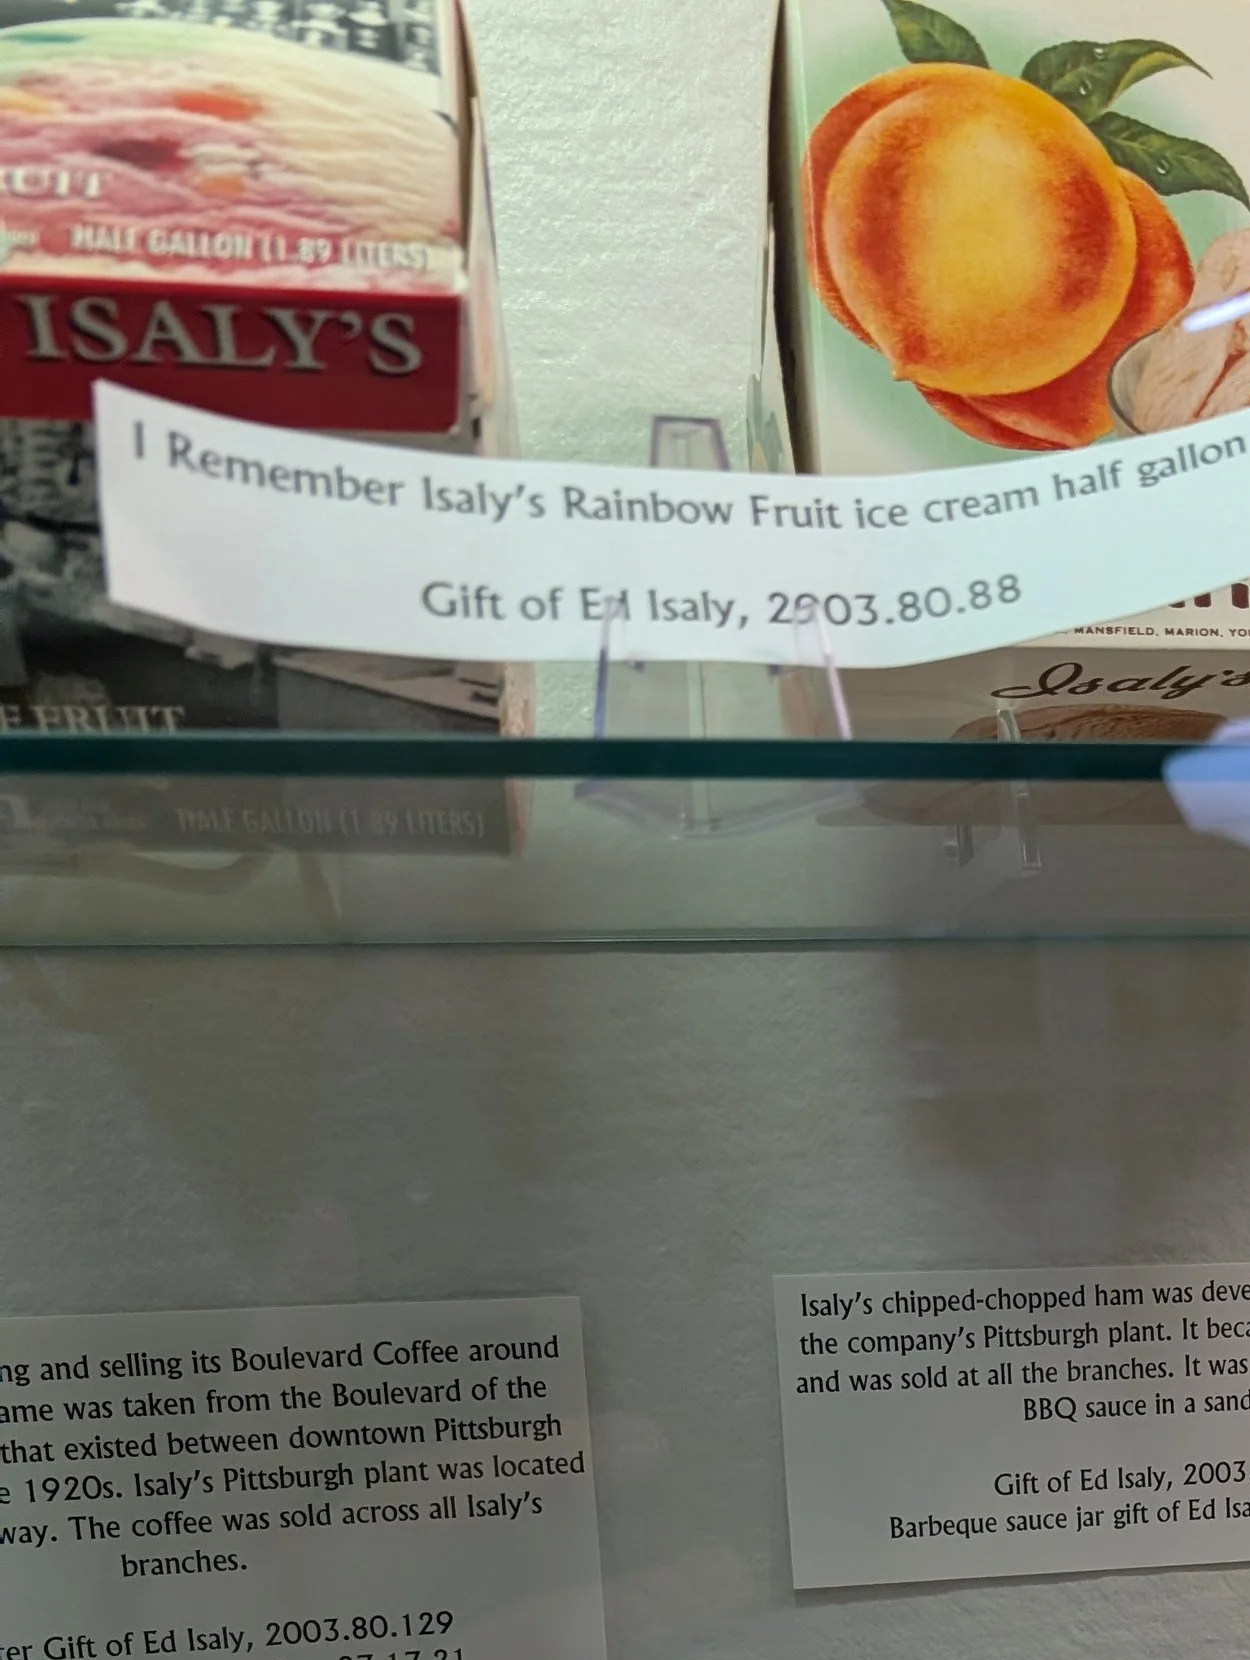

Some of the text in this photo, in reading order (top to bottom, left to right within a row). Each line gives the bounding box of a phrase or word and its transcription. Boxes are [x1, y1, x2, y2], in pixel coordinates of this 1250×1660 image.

[68, 224, 140, 252] HALF
[147, 228, 252, 260] GALLON
[341, 241, 434, 269] LITERS)
[19, 294, 423, 376] ISALY'S
[133, 420, 1247, 529] I Remember Isaly's Rainbow Fruit ice cream half gallon
[421, 581, 505, 621] Gift
[519, 589, 564, 621] of
[647, 588, 749, 630] Isaly,
[767, 573, 1022, 627] 2003.80.88
[800, 1291, 873, 1321] Isaly's
[882, 1284, 1086, 1318] chipped-chopped
[1094, 1283, 1144, 1307] ham
[1151, 1286, 1193, 1304] was
[40, 1334, 559, 1381] and selling its Boulevard Coffee around
[799, 1331, 838, 1356] the
[847, 1326, 976, 1357] company's
[983, 1321, 1099, 1349] Pittsburgh
[1108, 1320, 1172, 1348] plant.
[1182, 1317, 1200, 1341] It
[63, 1375, 547, 1421] was taken from the Boulevard of the
[1023, 1396, 1078, 1423] BBQ
[1085, 1399, 1147, 1418] sauce
[1155, 1392, 1175, 1415] in
[1184, 1397, 1196, 1414] a
[994, 1472, 1040, 1496] Gift
[1047, 1469, 1073, 1493] of
[1080, 1468, 1108, 1492] Ed
[1117, 1465, 1173, 1492] Isaly,
